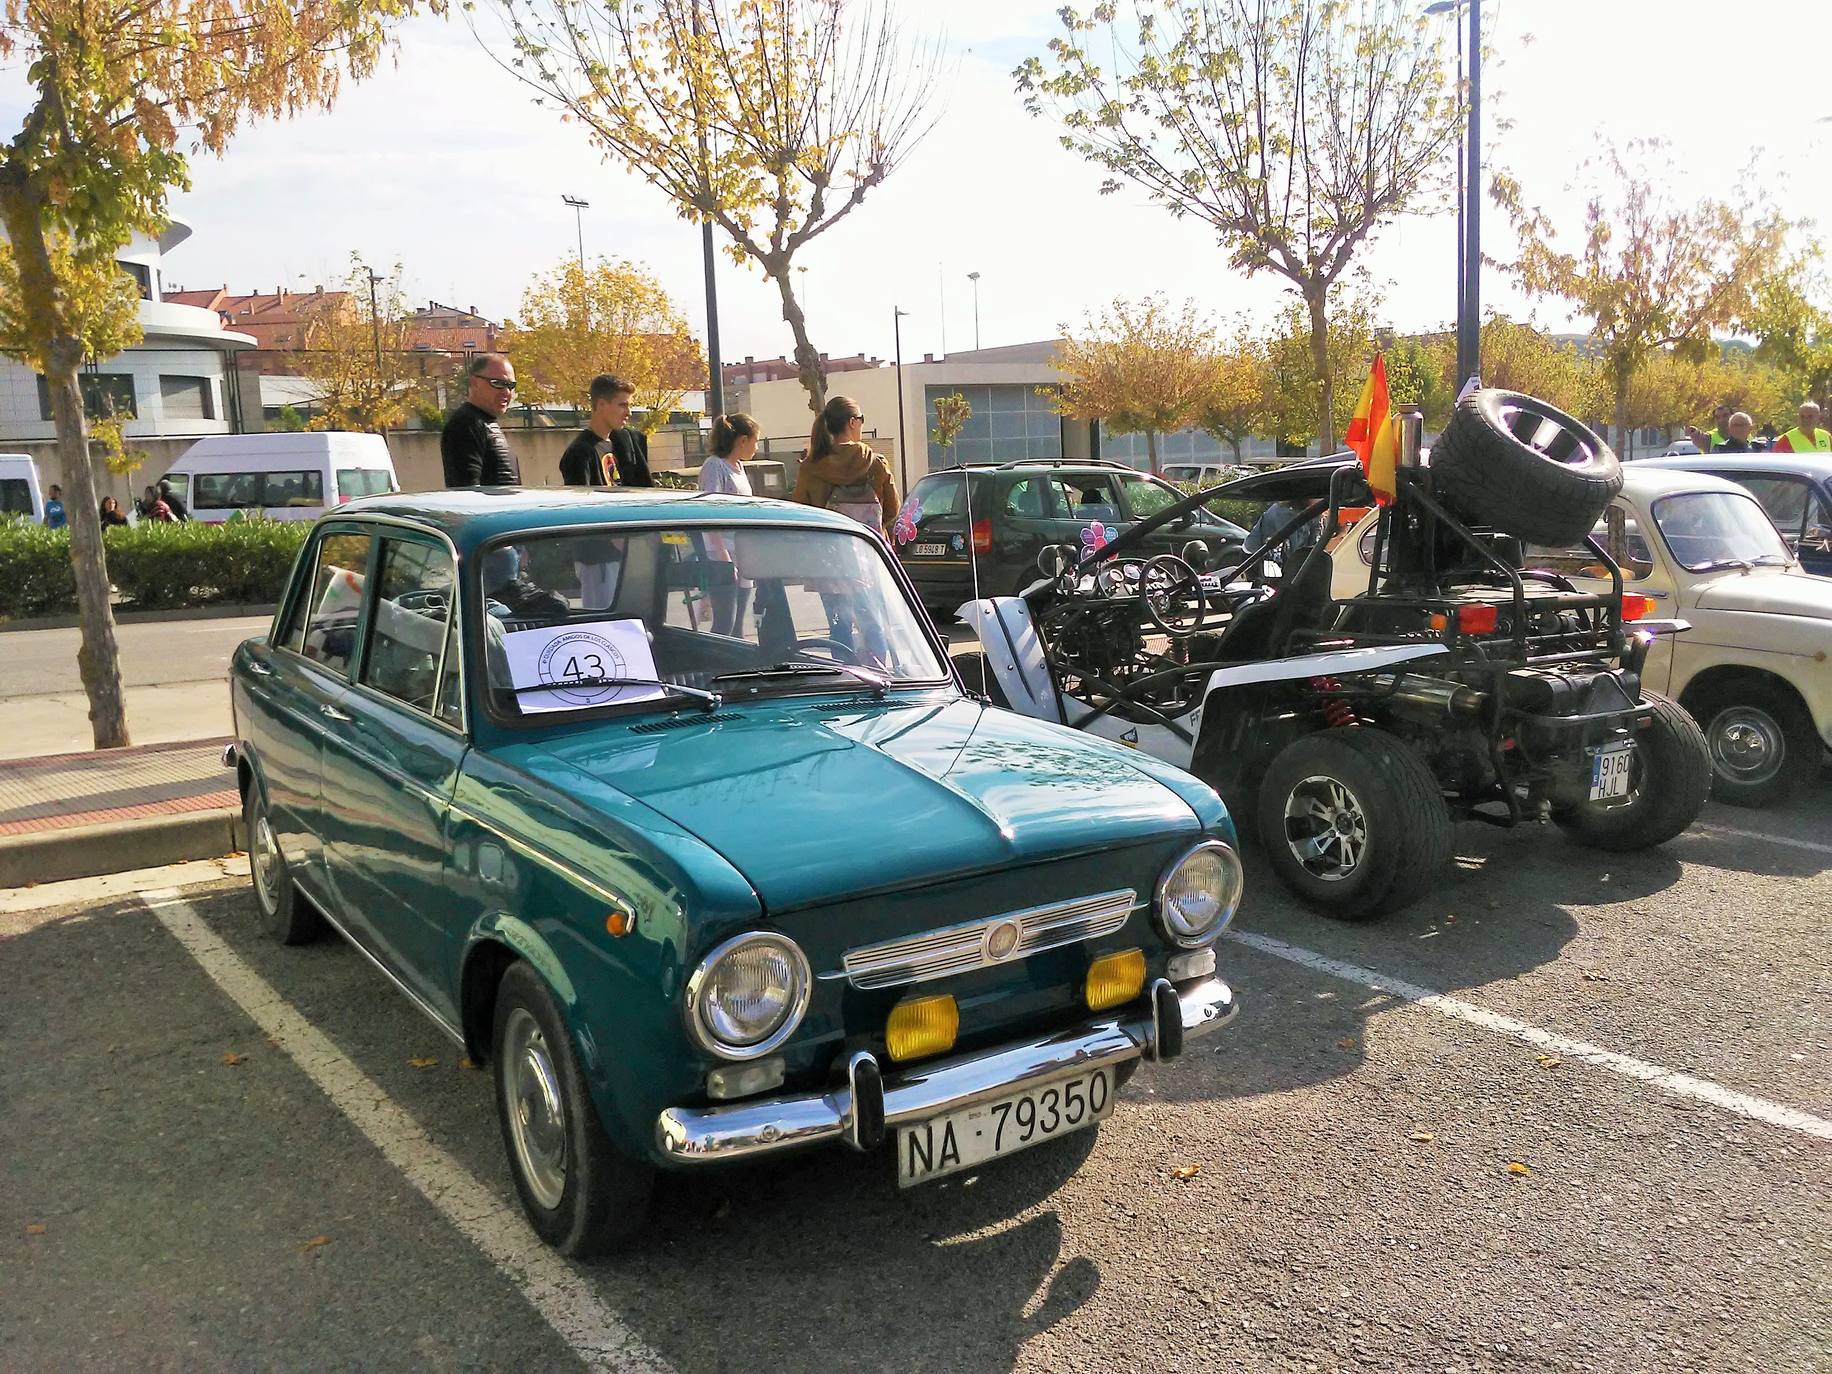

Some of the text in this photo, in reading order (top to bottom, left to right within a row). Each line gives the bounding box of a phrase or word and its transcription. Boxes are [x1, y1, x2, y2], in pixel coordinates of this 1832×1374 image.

[562, 634, 583, 642] AMIGOS
[562, 654, 605, 681] 43
[1602, 754, 1629, 776] 9160
[1598, 777, 1619, 798] HJL
